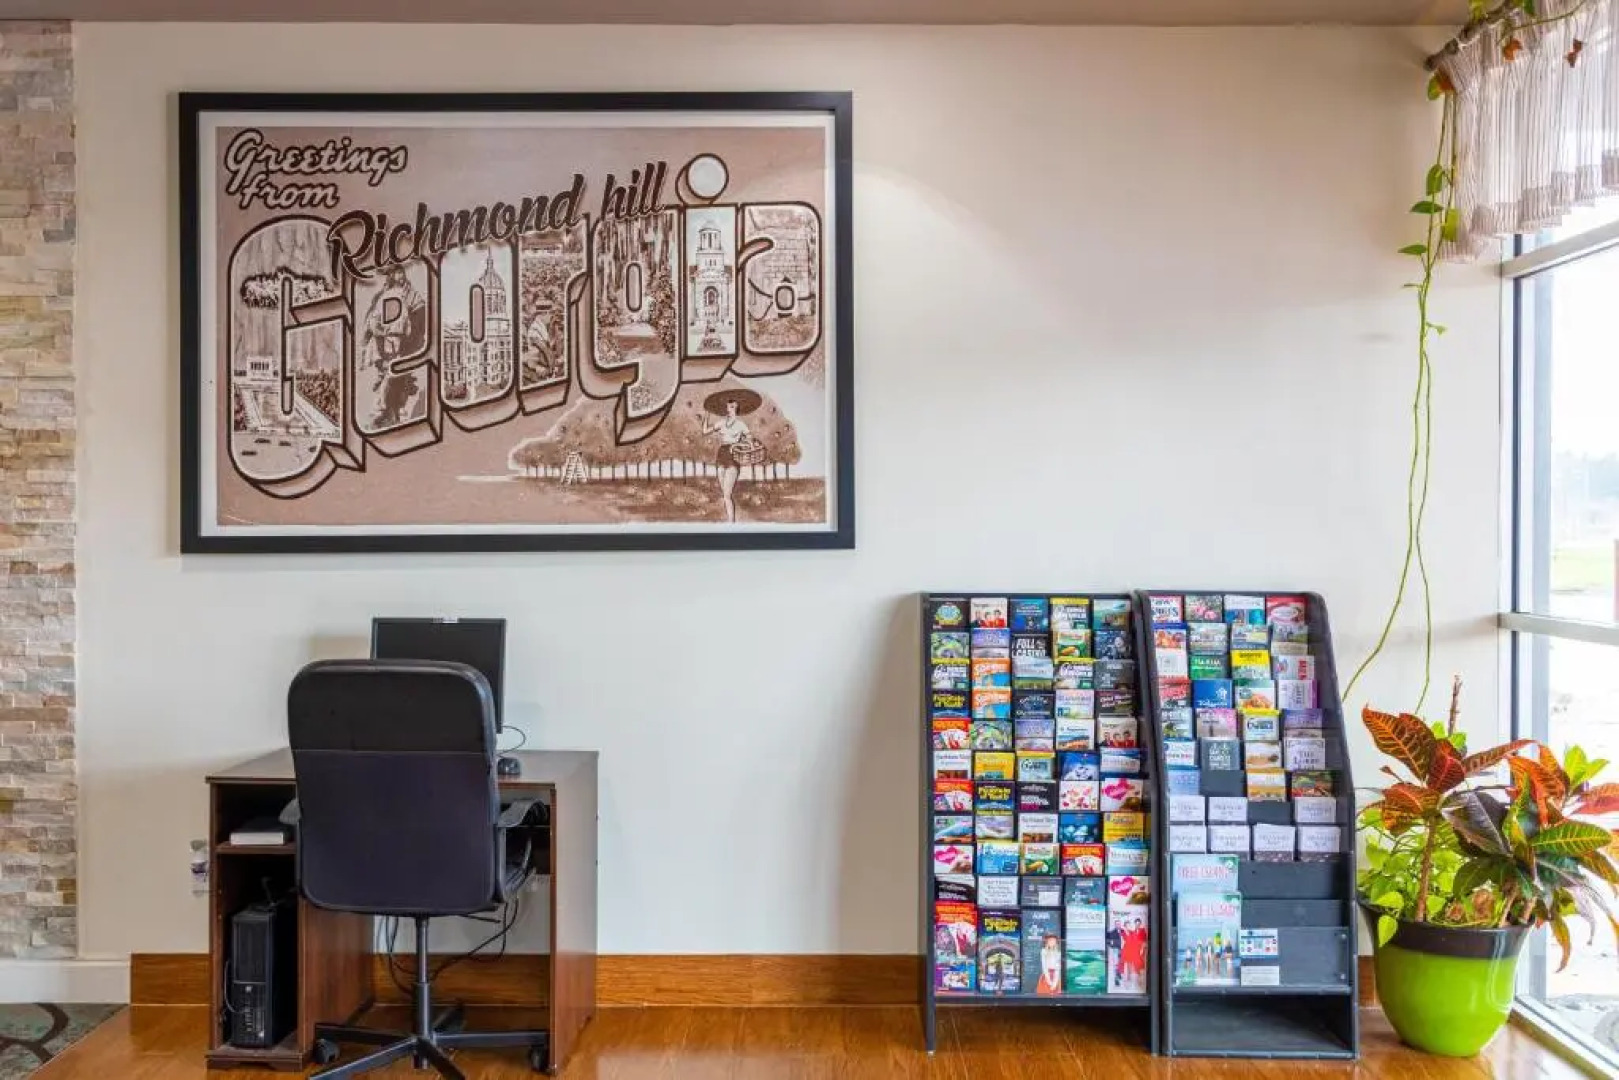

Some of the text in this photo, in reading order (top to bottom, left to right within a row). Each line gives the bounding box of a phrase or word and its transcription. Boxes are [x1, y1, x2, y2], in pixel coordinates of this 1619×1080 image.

[226, 128, 408, 193] Greetings
[240, 172, 340, 210] from
[328, 161, 669, 280] Richmond hill
[228, 154, 823, 499] Georgia
